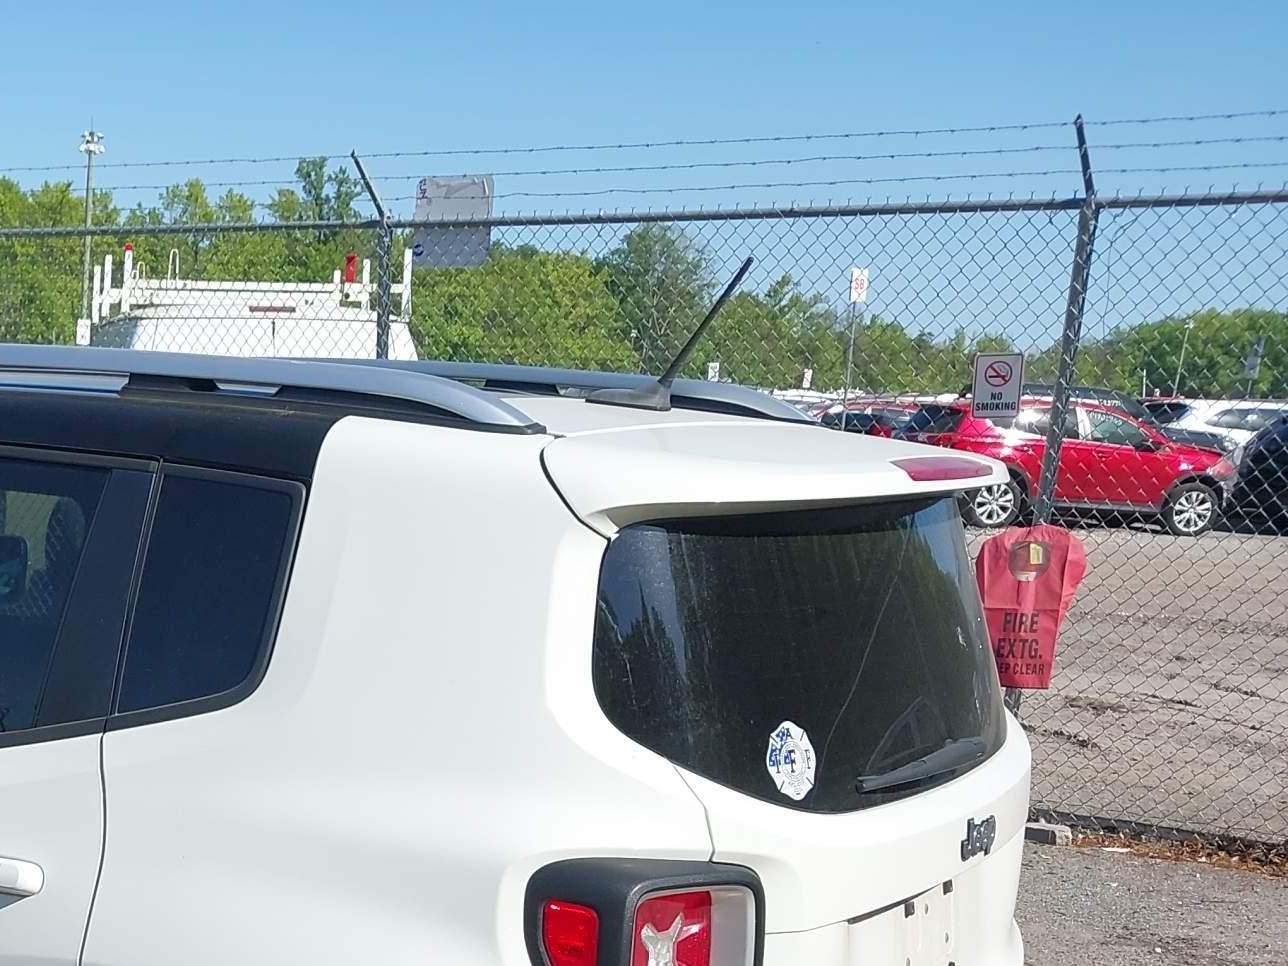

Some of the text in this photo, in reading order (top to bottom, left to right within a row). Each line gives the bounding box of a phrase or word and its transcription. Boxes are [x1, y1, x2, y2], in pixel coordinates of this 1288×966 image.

[990, 392, 1003, 401] NO
[975, 401, 1016, 412] SMOKING
[1002, 612, 1040, 634] FIRE
[996, 638, 1043, 660] EXTG.
[997, 662, 1045, 675] EP CLEAR
